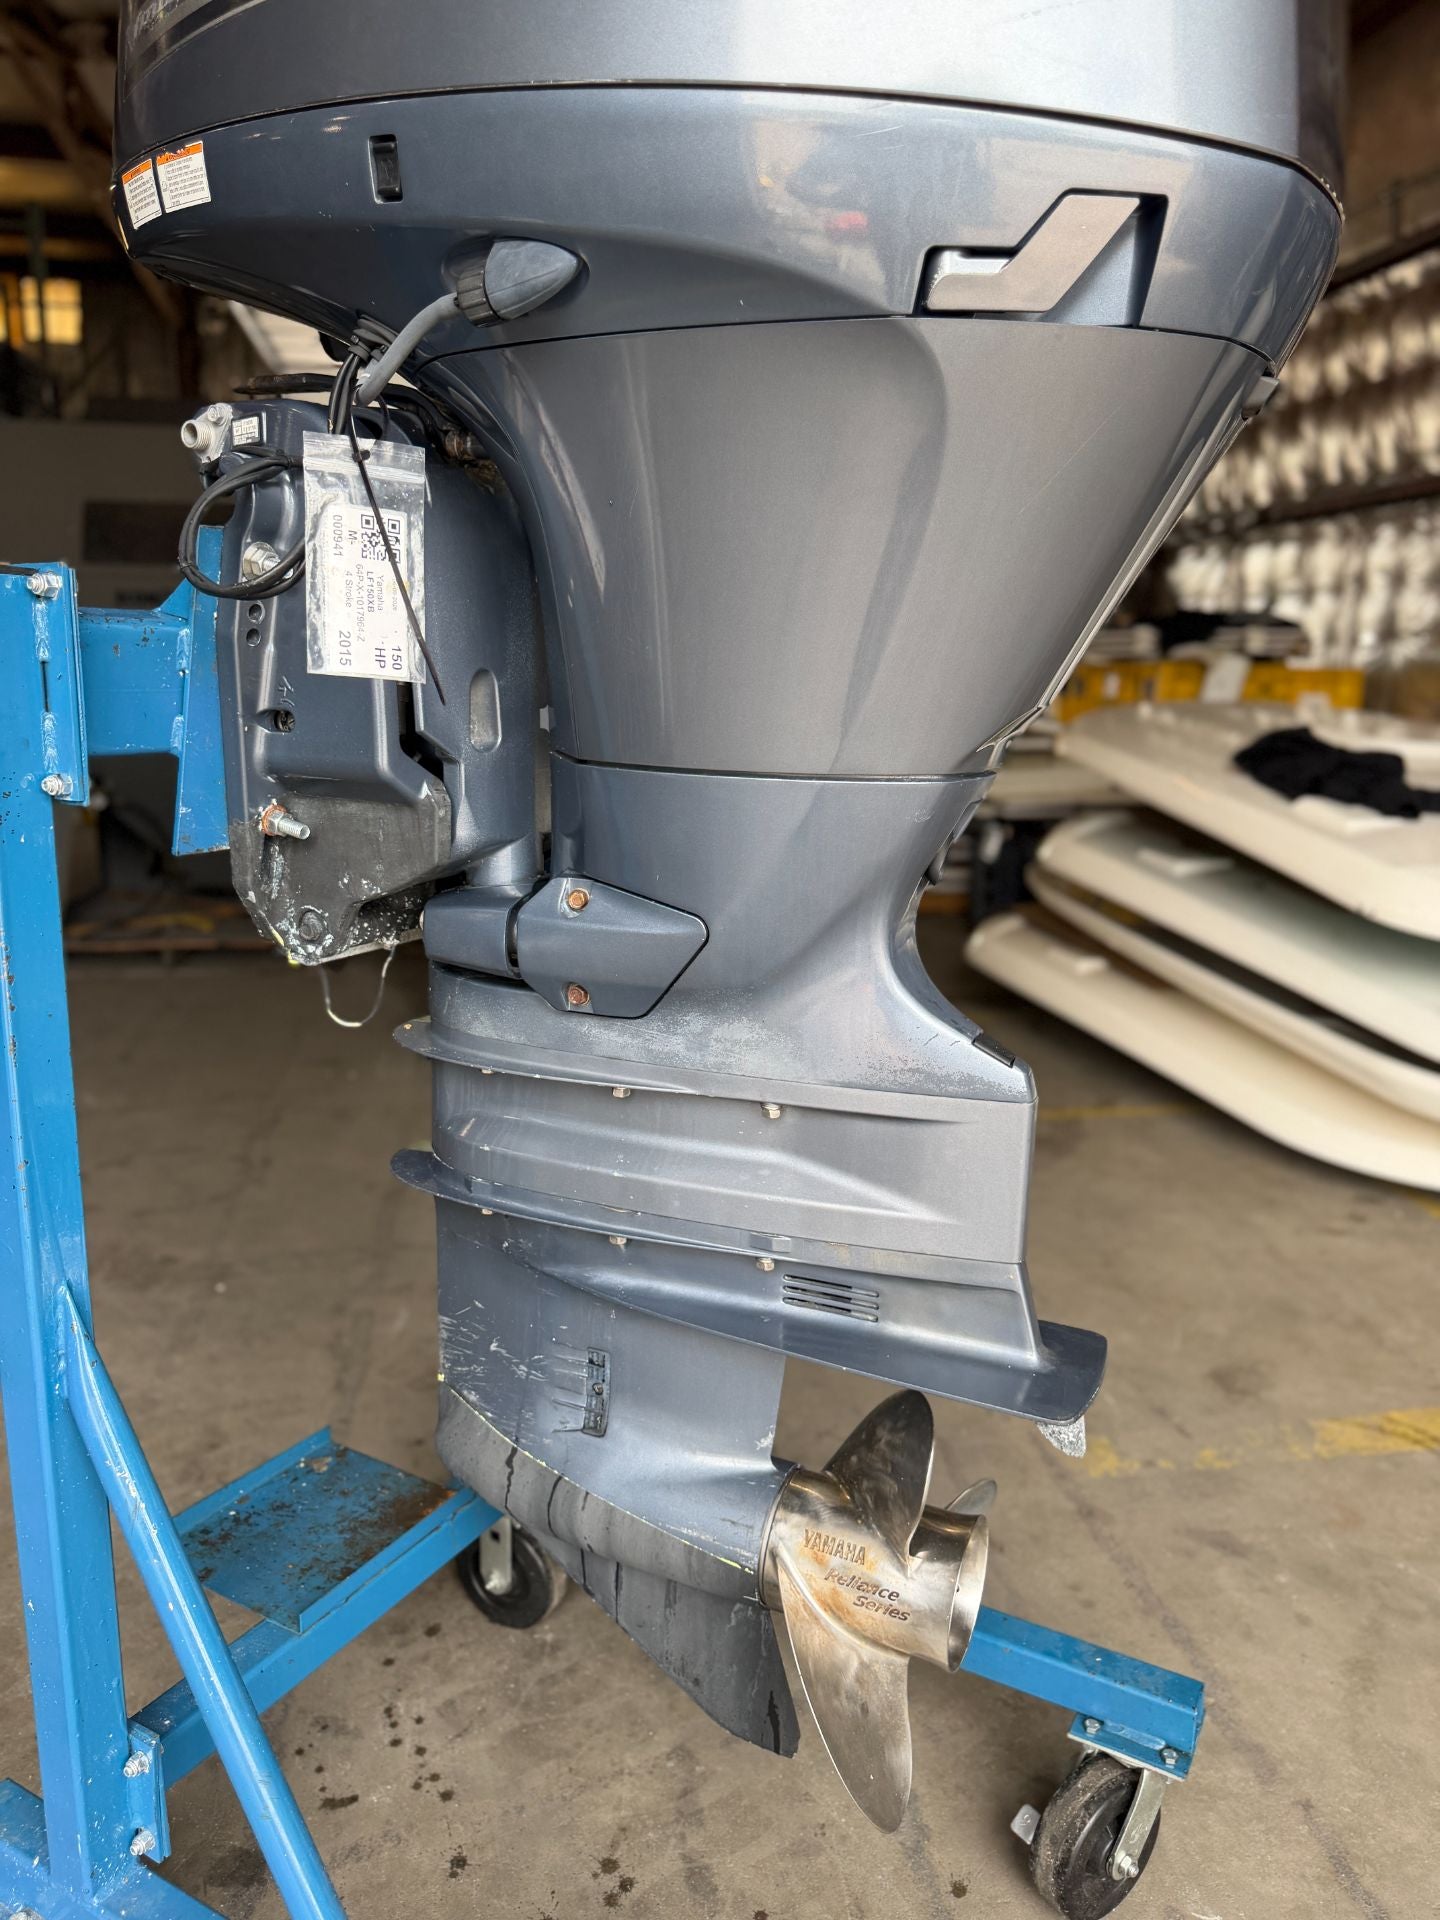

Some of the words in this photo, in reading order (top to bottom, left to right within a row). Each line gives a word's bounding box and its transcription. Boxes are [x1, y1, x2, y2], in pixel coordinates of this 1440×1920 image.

[332, 514, 344, 557] 000941
[345, 580, 354, 608] Stroke
[366, 570, 375, 613] LF150XB
[376, 574, 385, 611] Yamaha
[338, 629, 352, 667] 2015
[374, 647, 386, 669] HP
[391, 645, 403, 671] 150
[804, 1528, 866, 1566] YAMAHA
[824, 1567, 900, 1602] Reliance
[852, 1595, 911, 1622] Series
